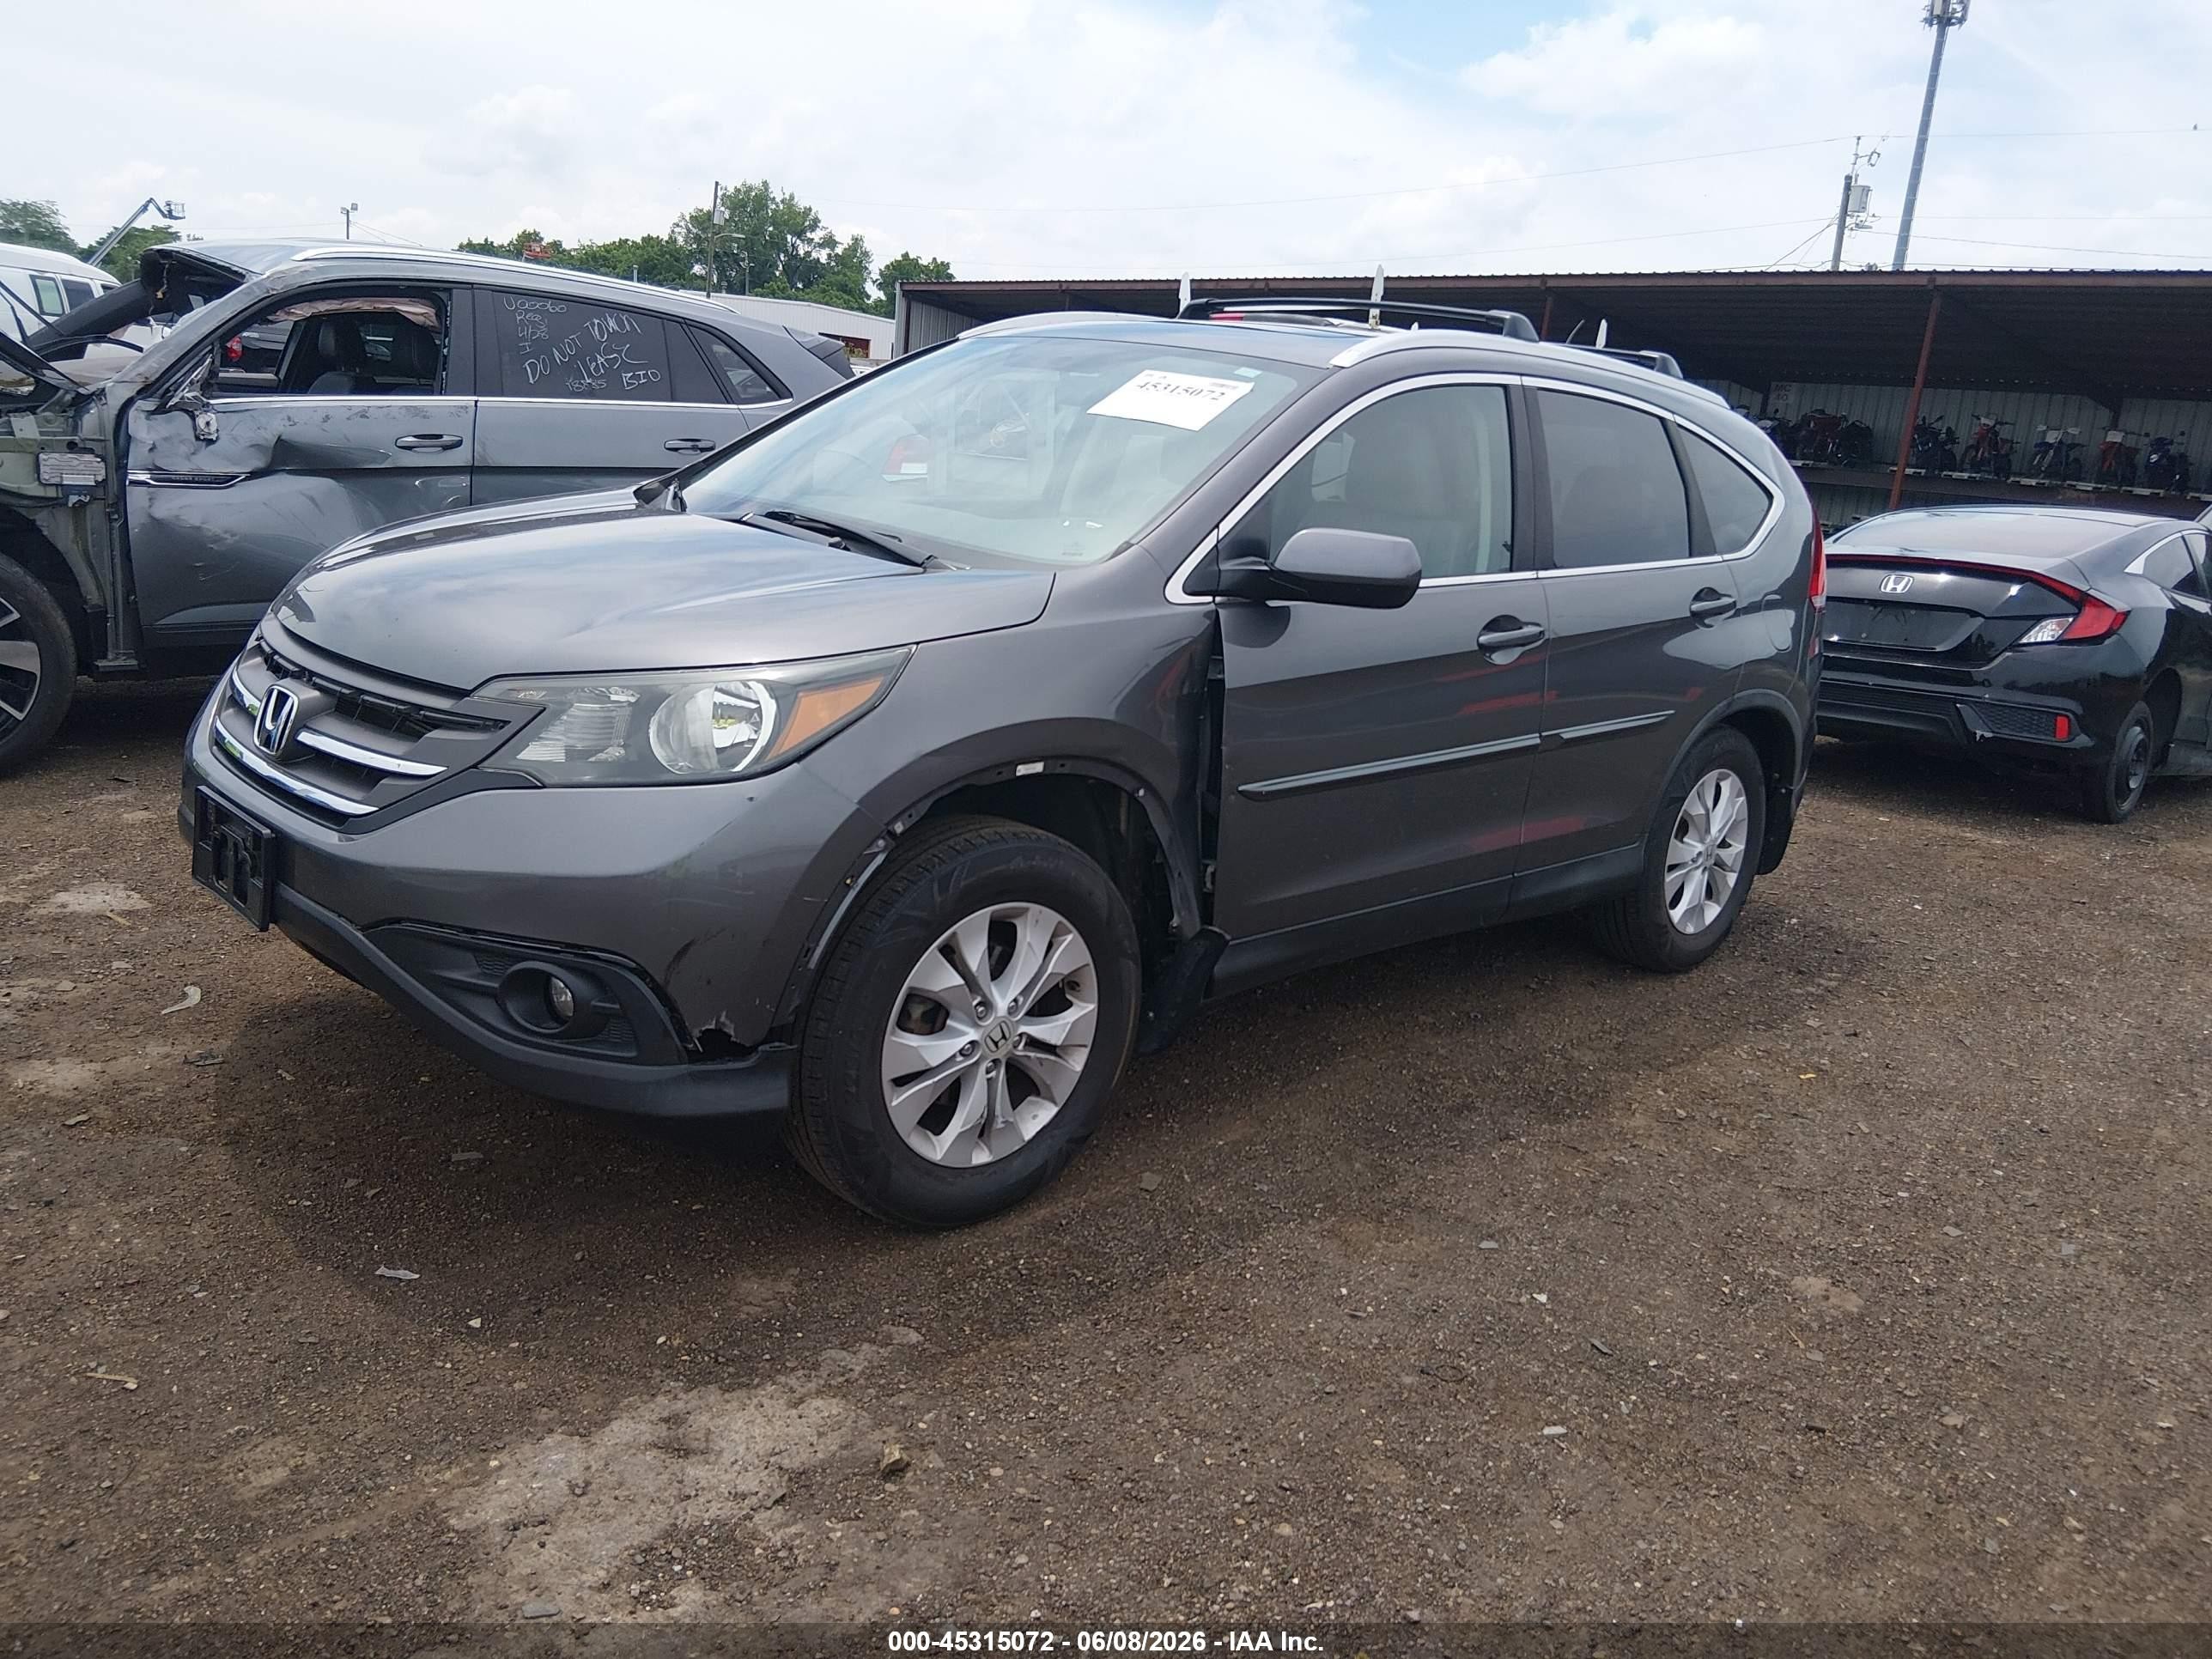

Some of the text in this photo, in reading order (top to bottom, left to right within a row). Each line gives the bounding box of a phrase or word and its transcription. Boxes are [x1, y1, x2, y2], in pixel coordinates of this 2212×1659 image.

[523, 355, 550, 384] DO
[552, 331, 583, 366] NOT
[1136, 381, 1226, 401] 45315072
